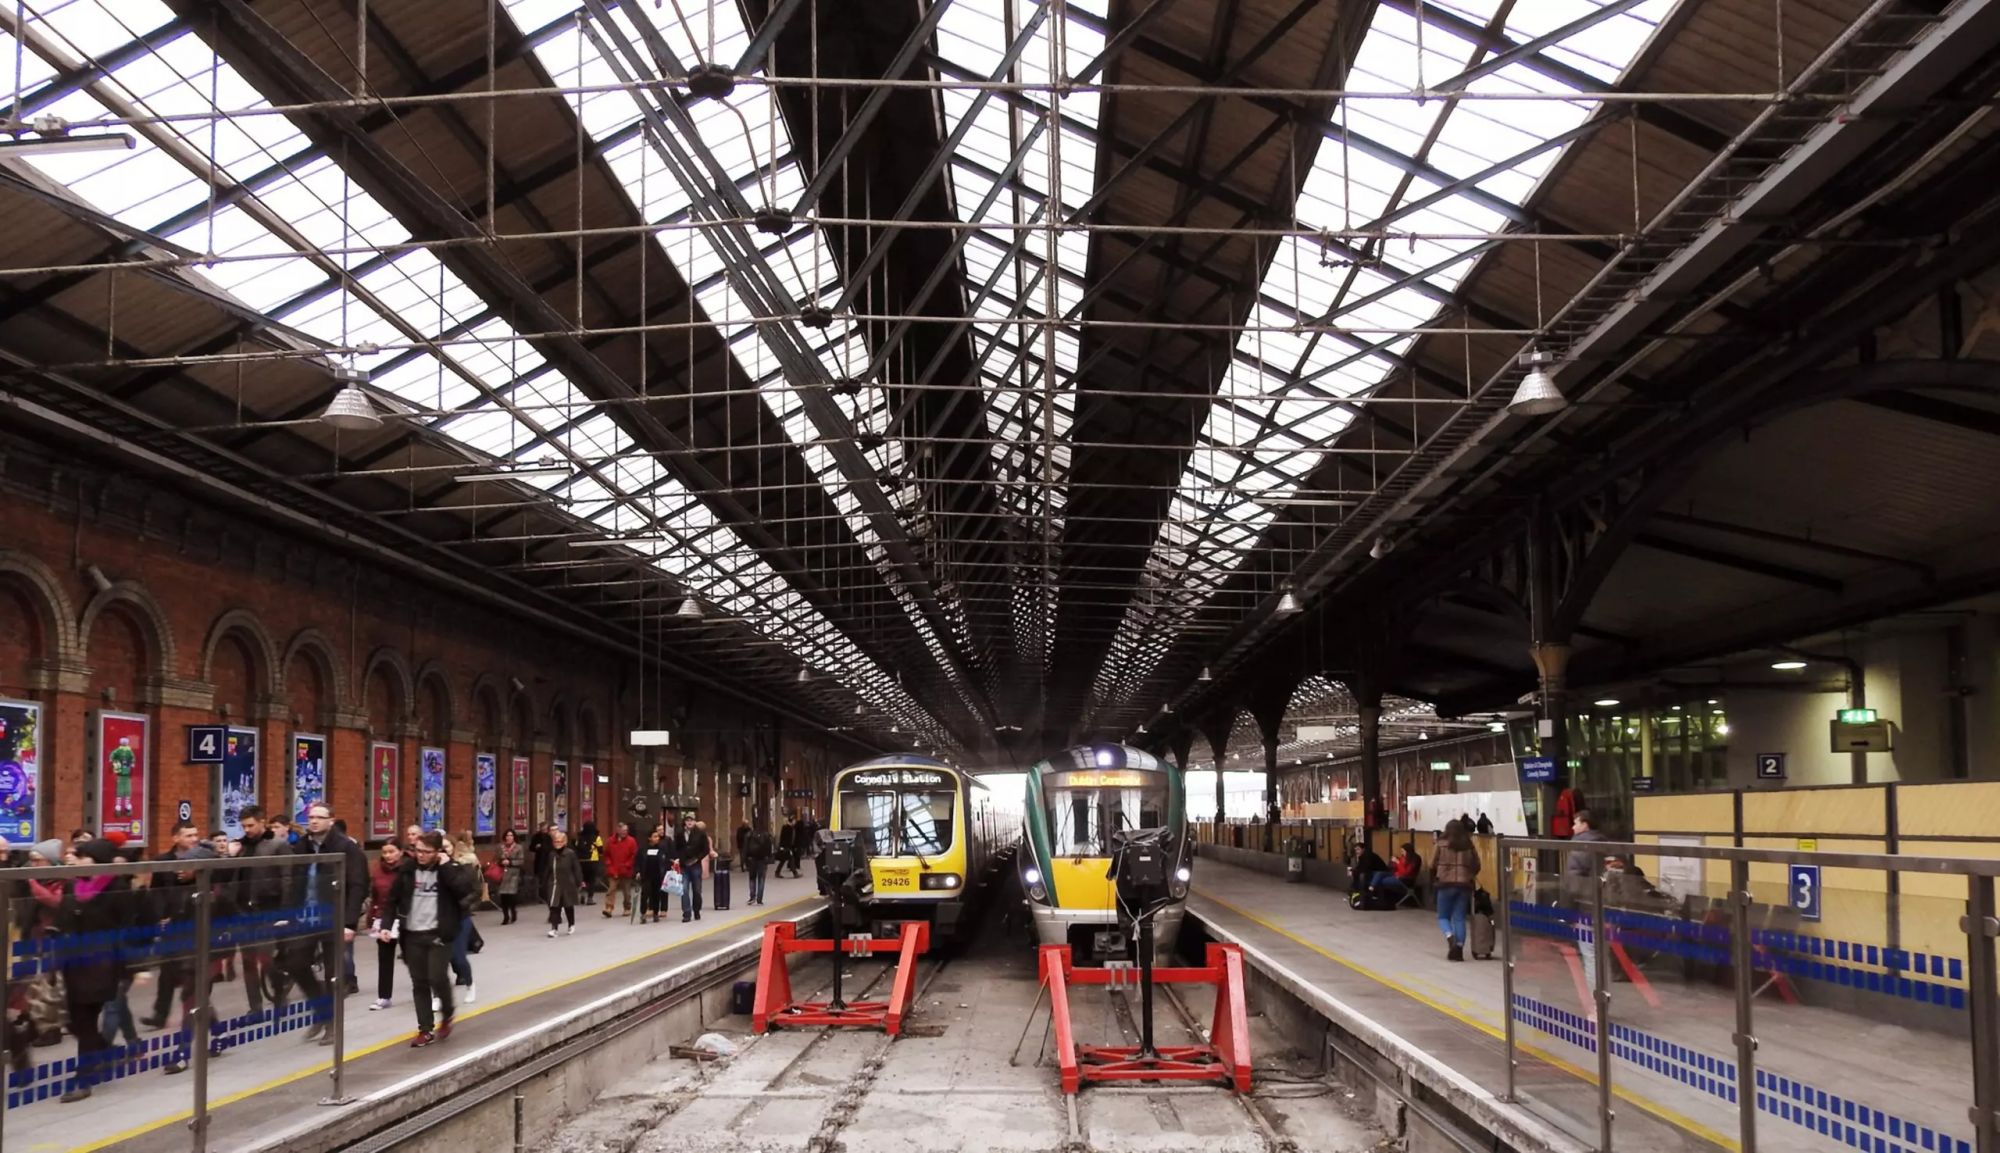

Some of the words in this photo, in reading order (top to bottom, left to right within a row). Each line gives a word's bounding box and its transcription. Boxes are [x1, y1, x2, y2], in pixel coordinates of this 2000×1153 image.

[199, 733, 216, 755] 4
[1765, 758, 1777, 774] 2
[902, 774, 941, 784] Station
[881, 877, 910, 886] 29426
[1797, 873, 1811, 909] 3
